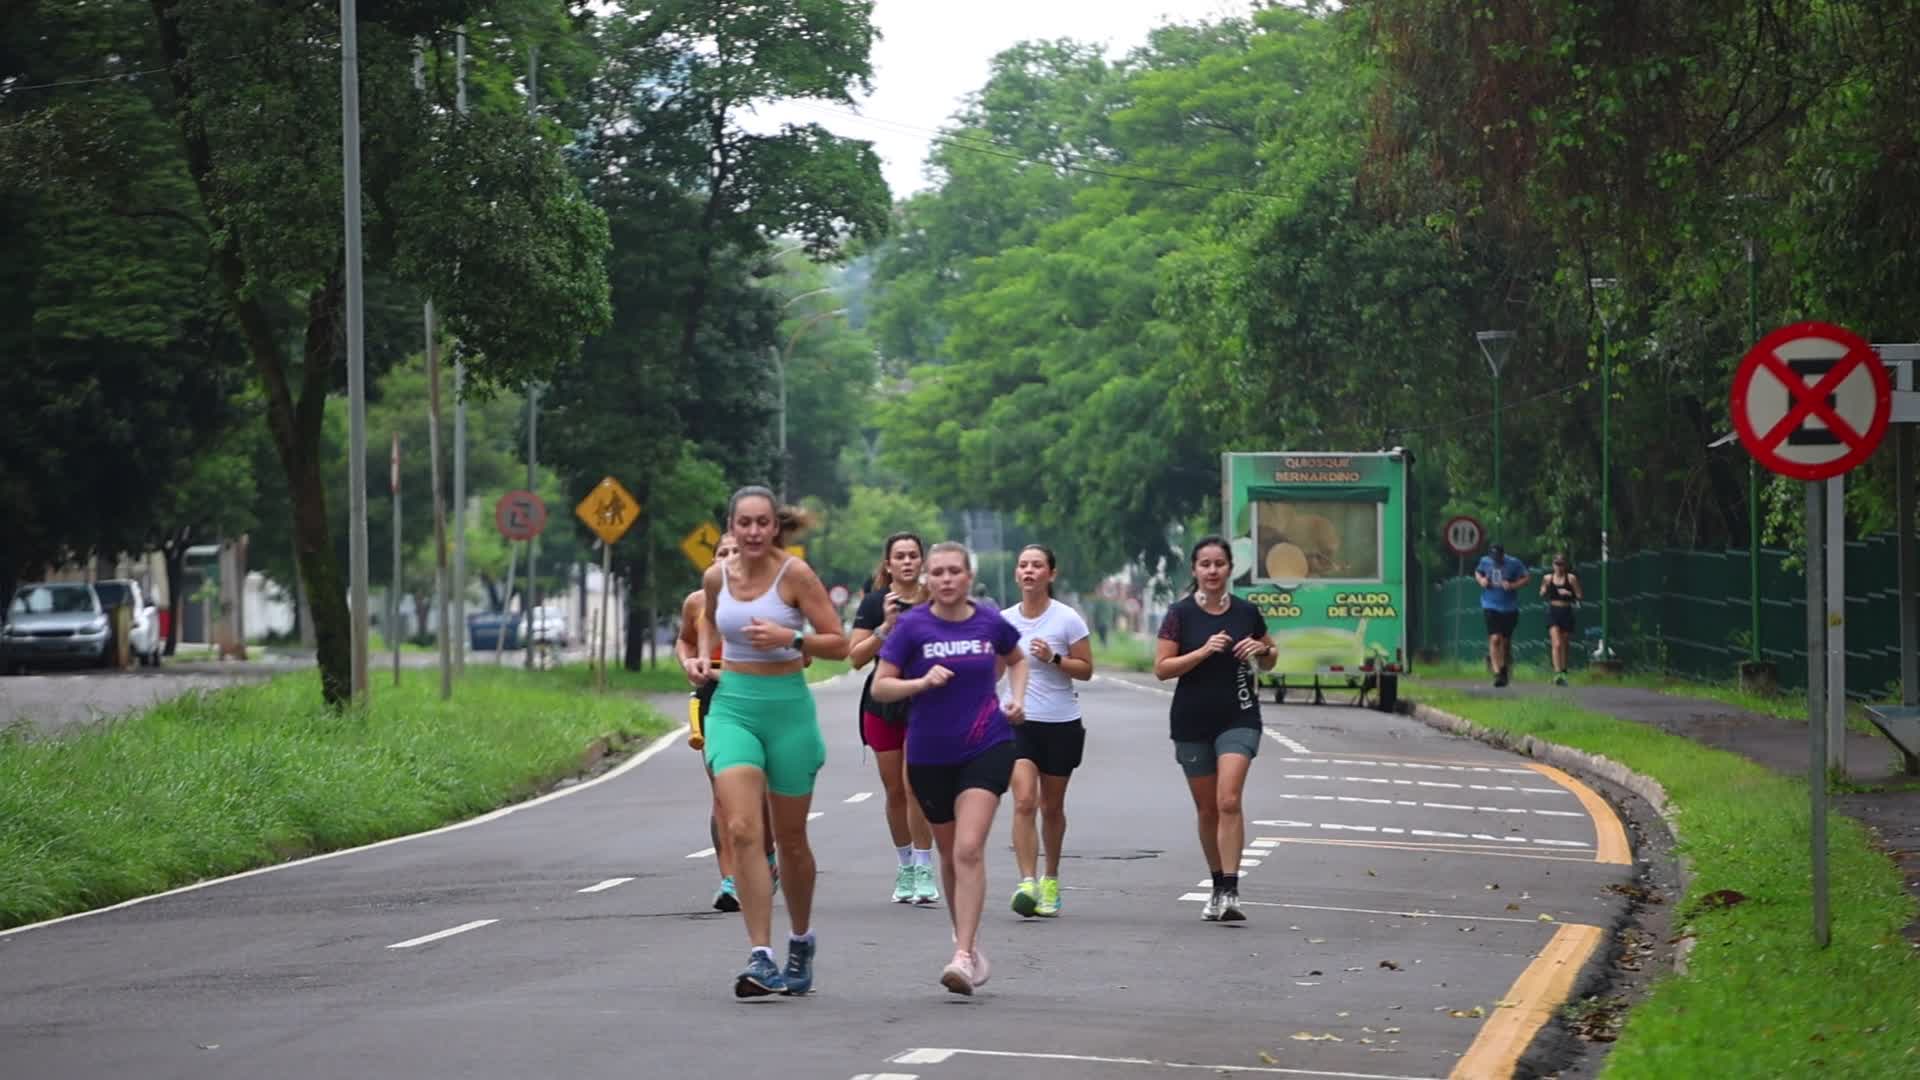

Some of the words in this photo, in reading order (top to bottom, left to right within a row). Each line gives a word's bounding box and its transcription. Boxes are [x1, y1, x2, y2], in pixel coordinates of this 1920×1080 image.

[1286, 458, 1350, 467] QUIOSQUE
[1275, 471, 1360, 481] BERNARDINO
[1248, 593, 1292, 604] COCO
[1335, 593, 1389, 604] CALDO
[1258, 606, 1301, 617] LADO
[1327, 606, 1348, 617] DE
[1351, 606, 1395, 617] CANA
[922, 640, 981, 659] EQUIPE
